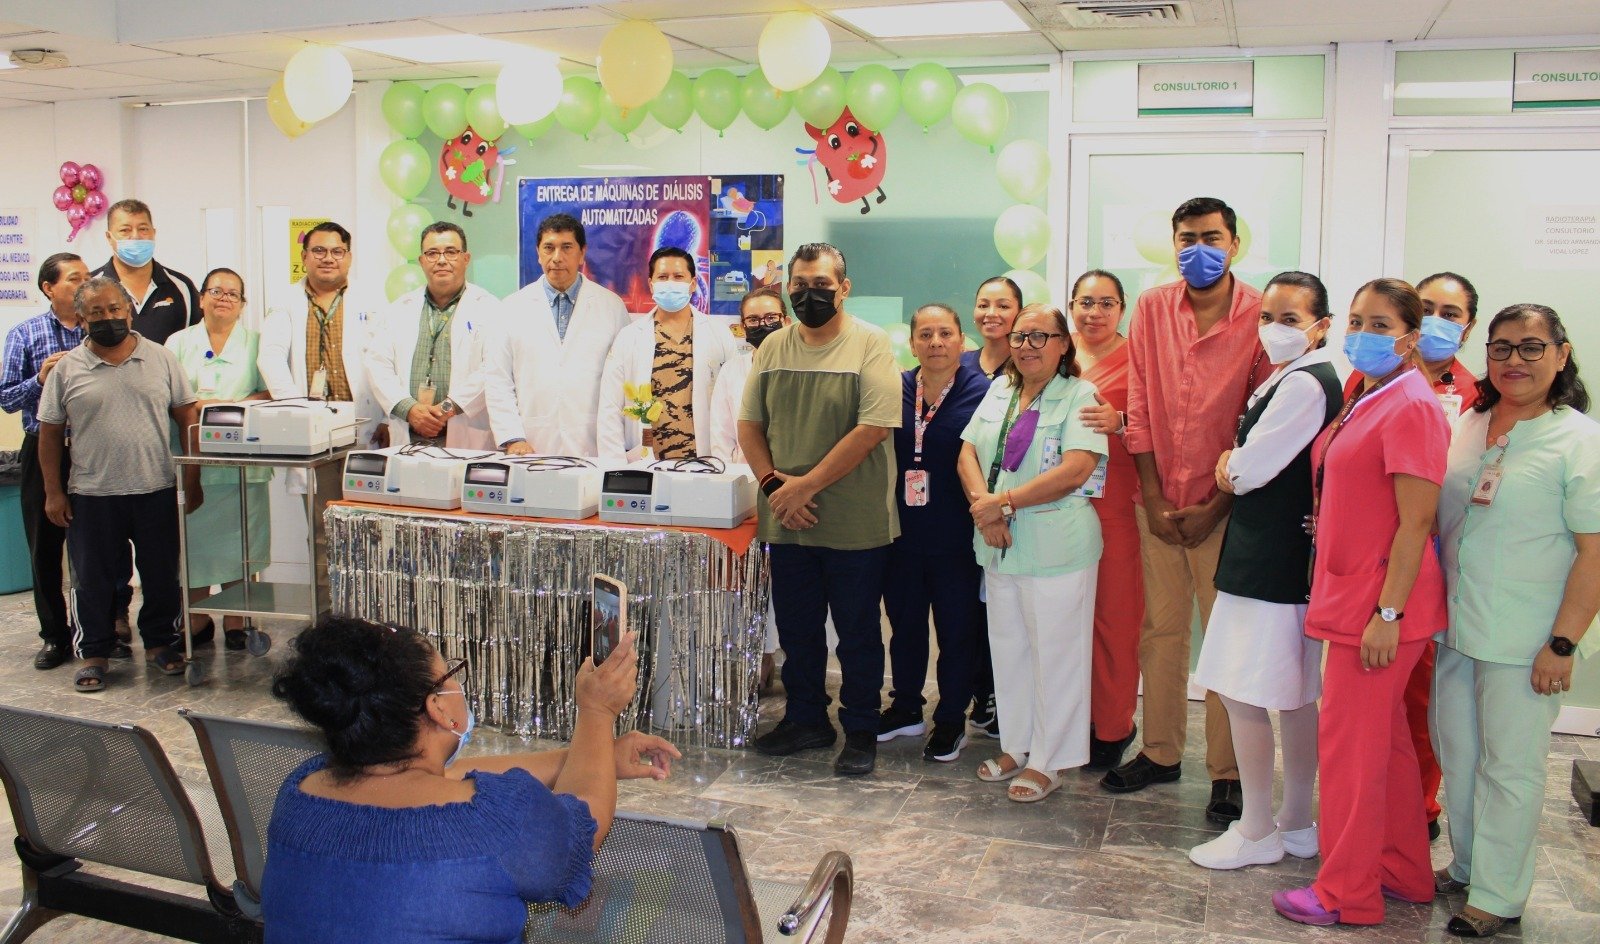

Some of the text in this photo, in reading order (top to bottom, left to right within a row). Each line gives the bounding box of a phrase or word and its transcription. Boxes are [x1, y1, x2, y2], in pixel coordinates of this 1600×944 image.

[1532, 72, 1600, 82] CONSULTO
[1153, 81, 1238, 92] CONSULTORIO 1
[537, 180, 703, 202] ENTREGA DE MÁQUINAS DE DIÁLISIS
[581, 208, 658, 226] AUTOMATIZADAS
[12, 271, 29, 281] ANTES
